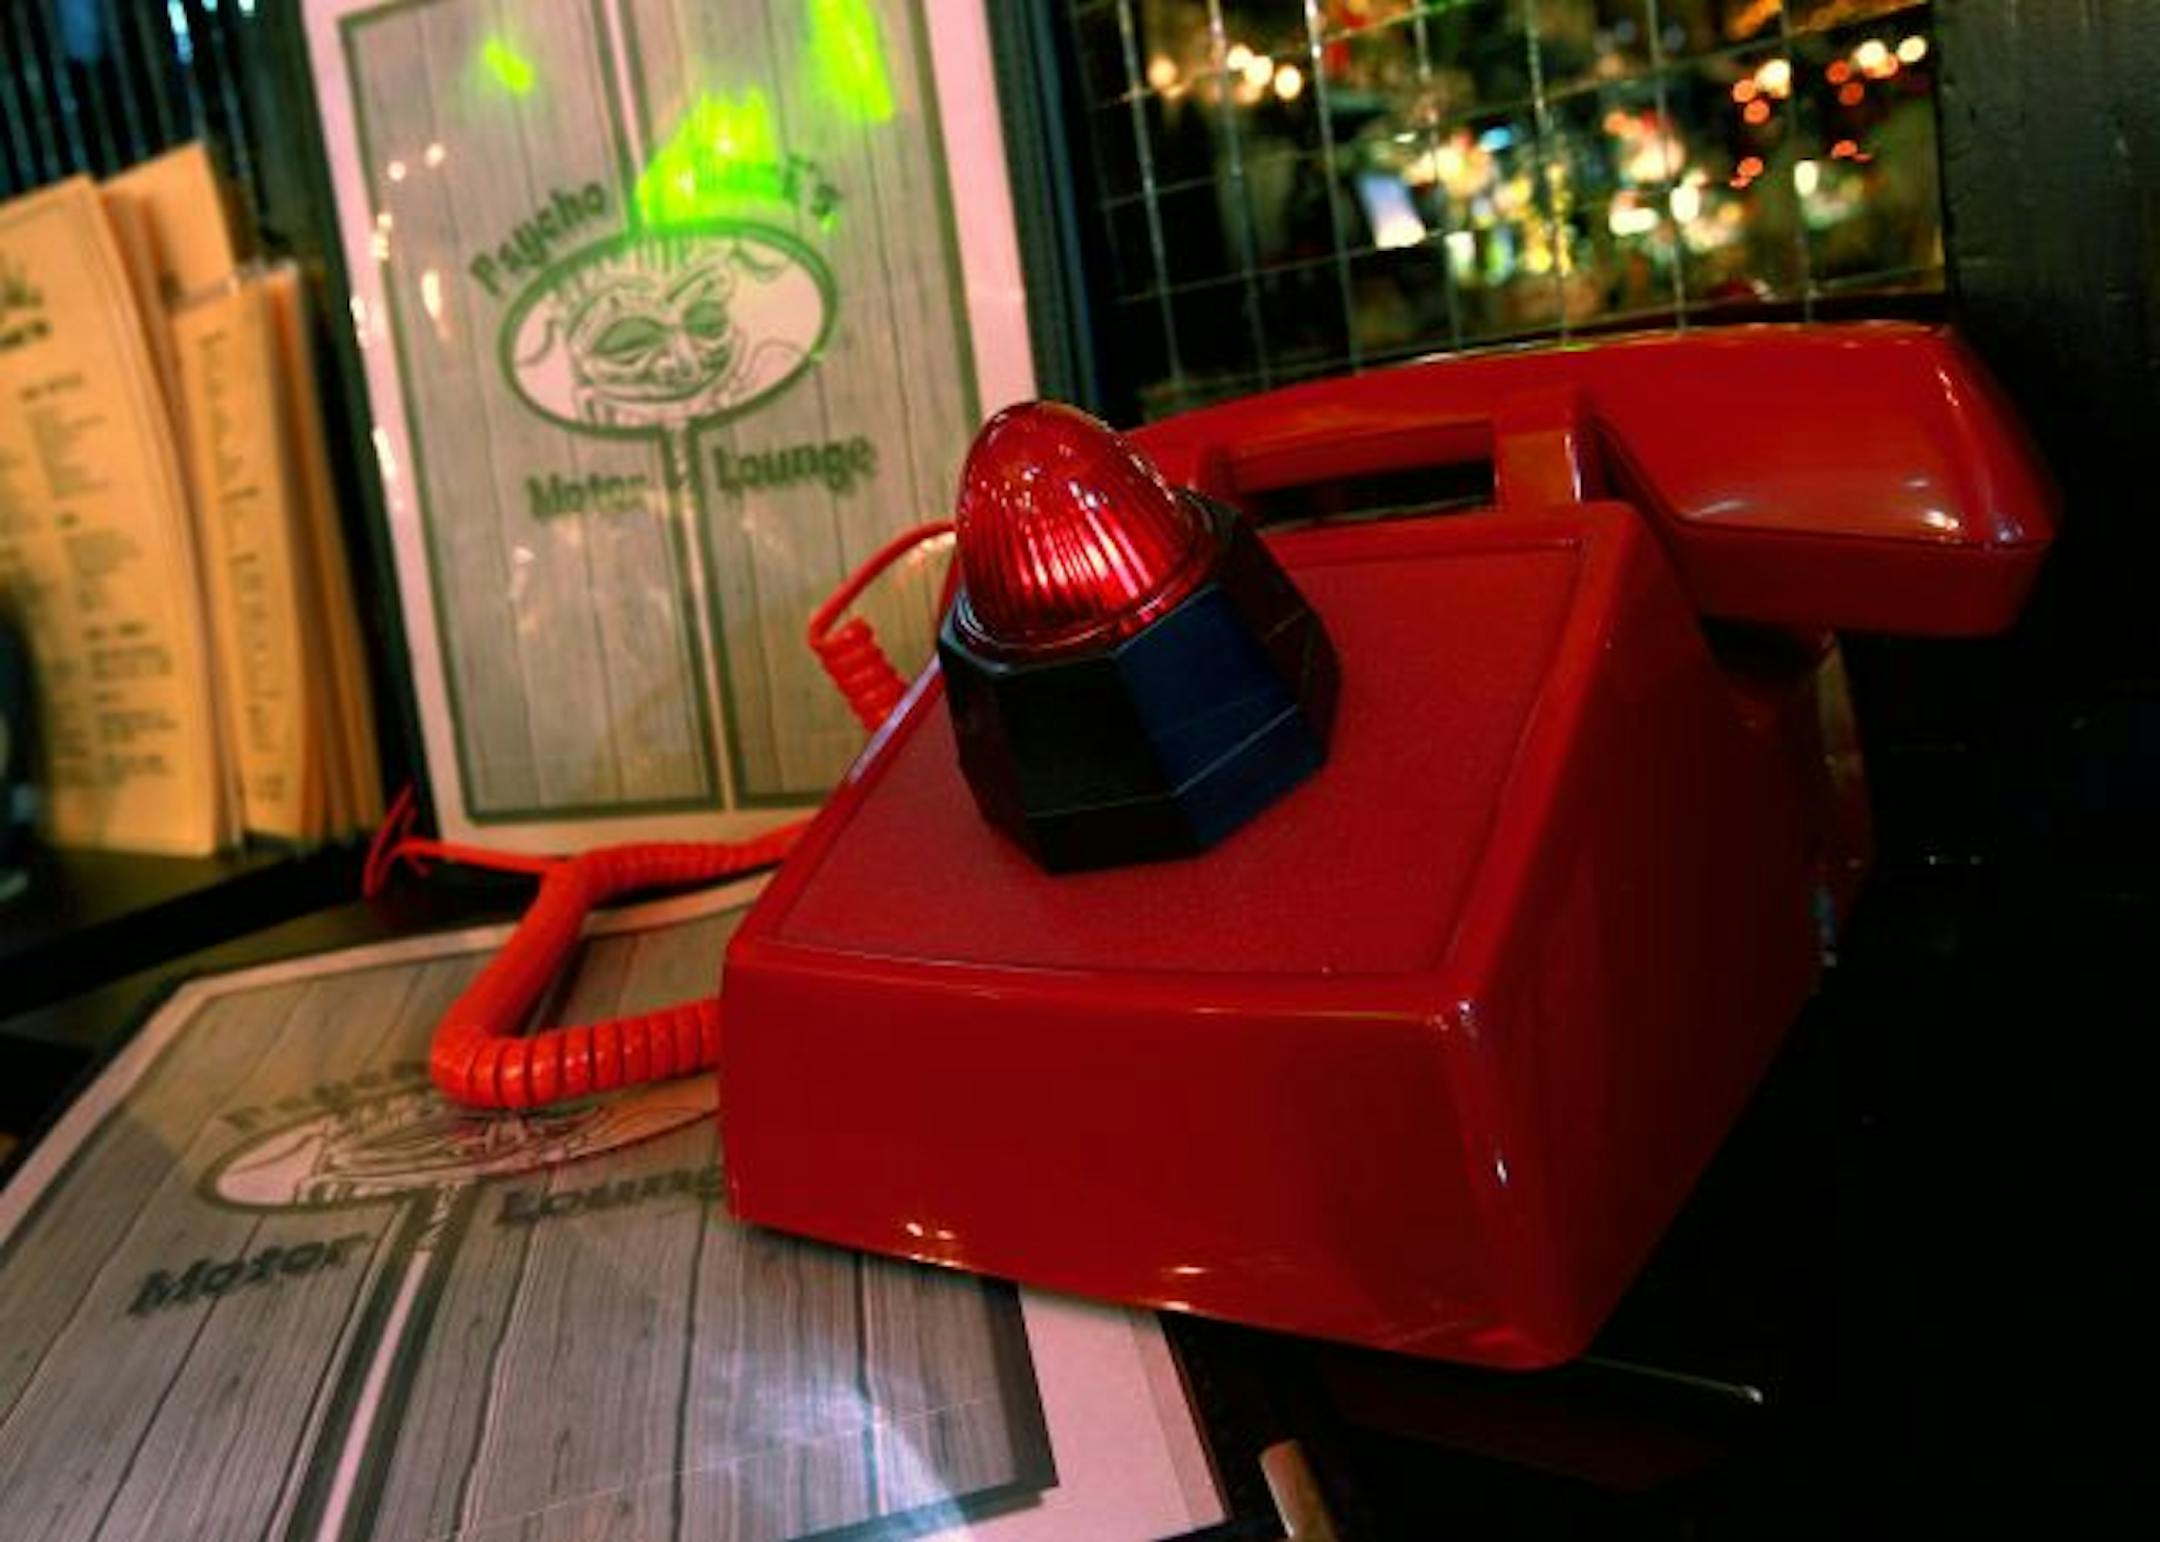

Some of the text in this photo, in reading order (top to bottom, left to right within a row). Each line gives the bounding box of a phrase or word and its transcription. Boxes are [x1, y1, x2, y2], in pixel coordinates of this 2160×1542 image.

[469, 182, 607, 297] Psycho
[713, 435, 877, 494] Lounge
[126, 1233, 370, 1317] Motor
